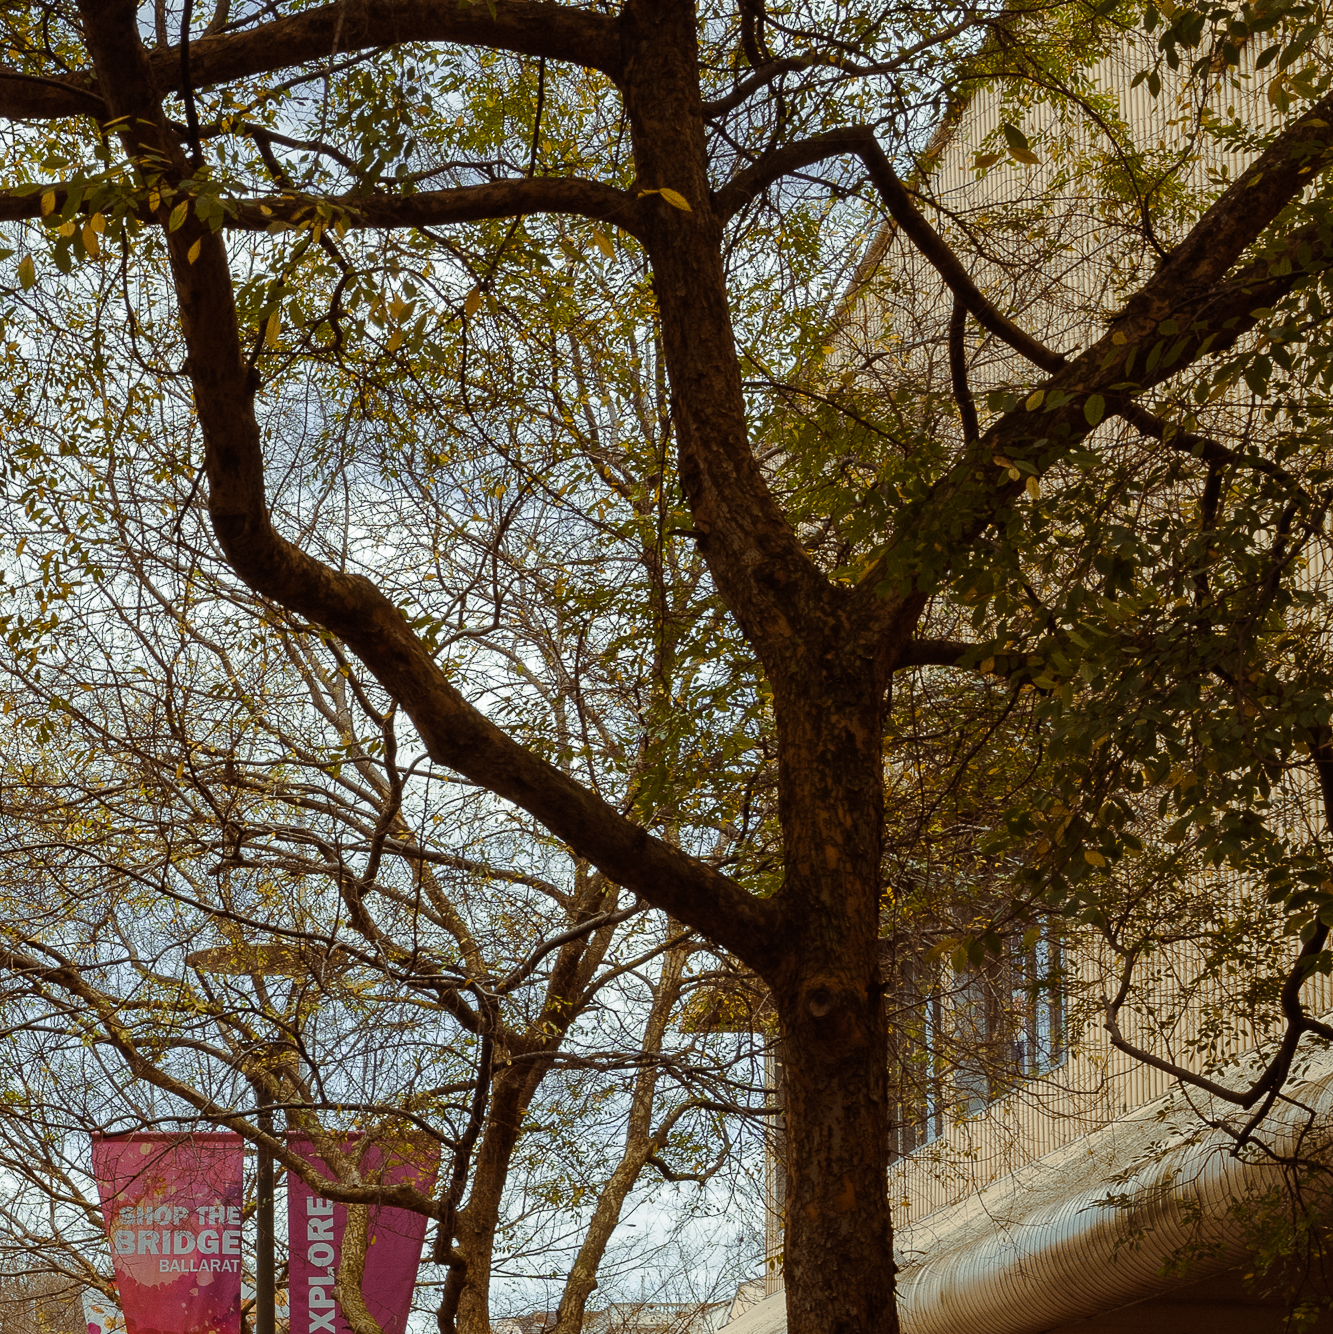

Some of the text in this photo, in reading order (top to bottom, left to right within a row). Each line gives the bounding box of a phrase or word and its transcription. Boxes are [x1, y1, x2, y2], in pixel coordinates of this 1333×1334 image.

[119, 1205, 241, 1226] SHOP THE
[114, 1230, 241, 1256] BRIDGE
[159, 1258, 241, 1273] BALLARAT
